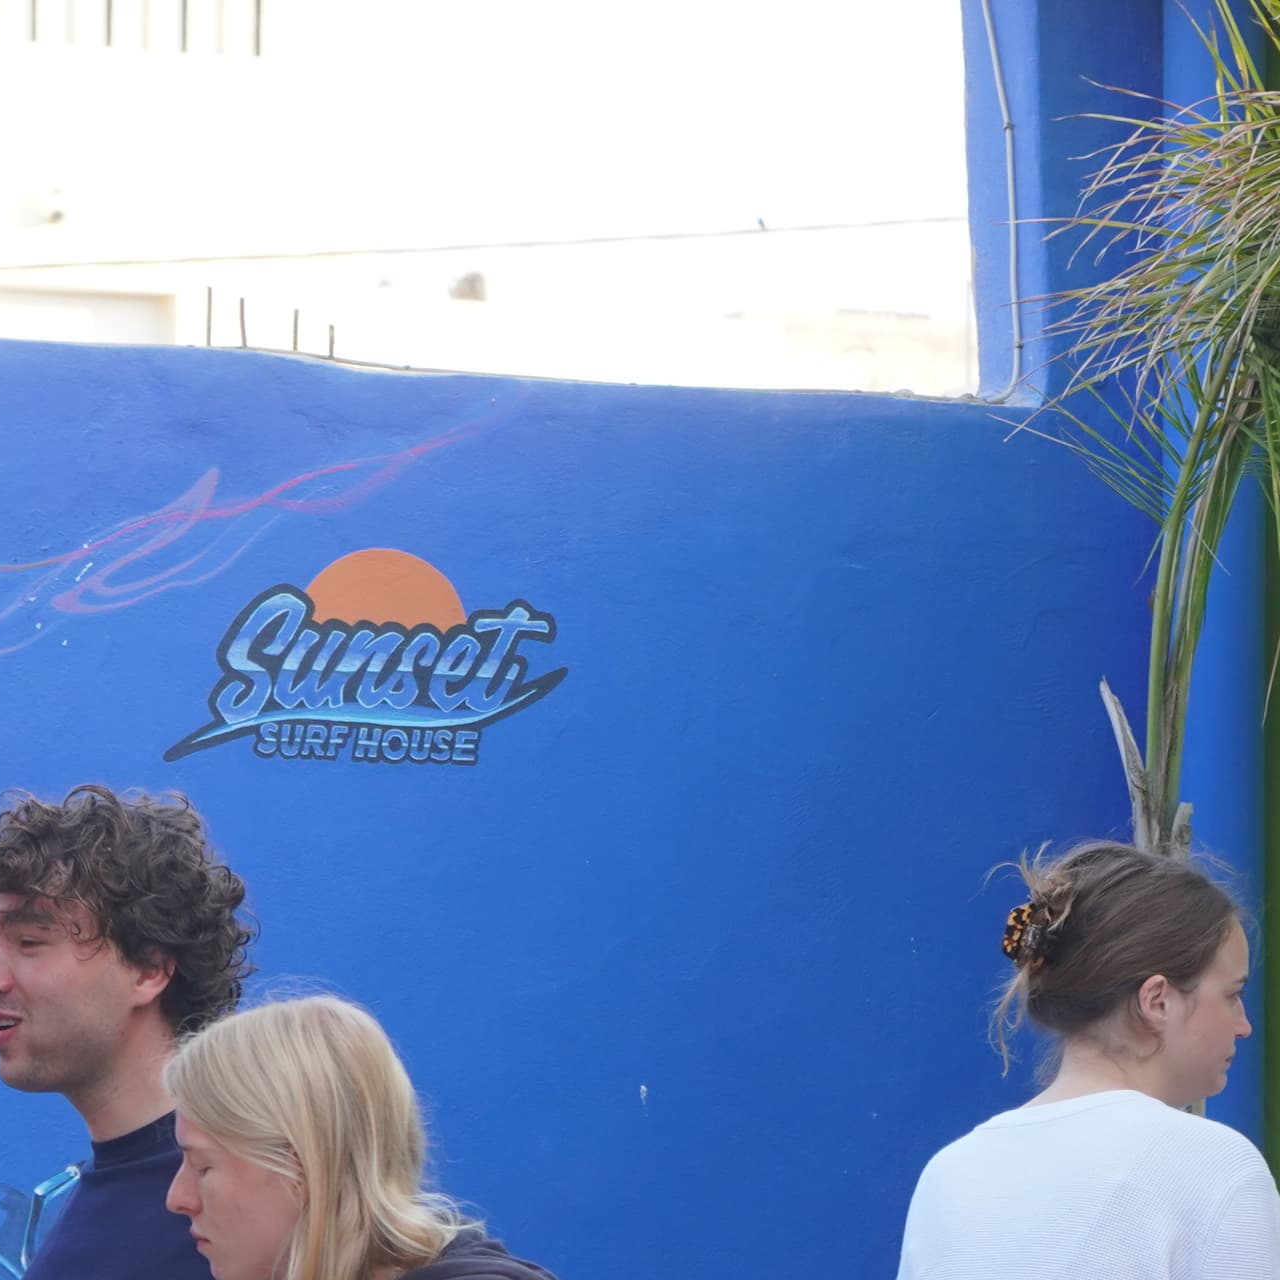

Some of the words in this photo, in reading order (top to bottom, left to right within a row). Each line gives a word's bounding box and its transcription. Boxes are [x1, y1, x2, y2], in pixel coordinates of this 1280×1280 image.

[214, 590, 551, 724] Sunset
[257, 722, 350, 758] SURF
[353, 727, 478, 762] HOUSE
